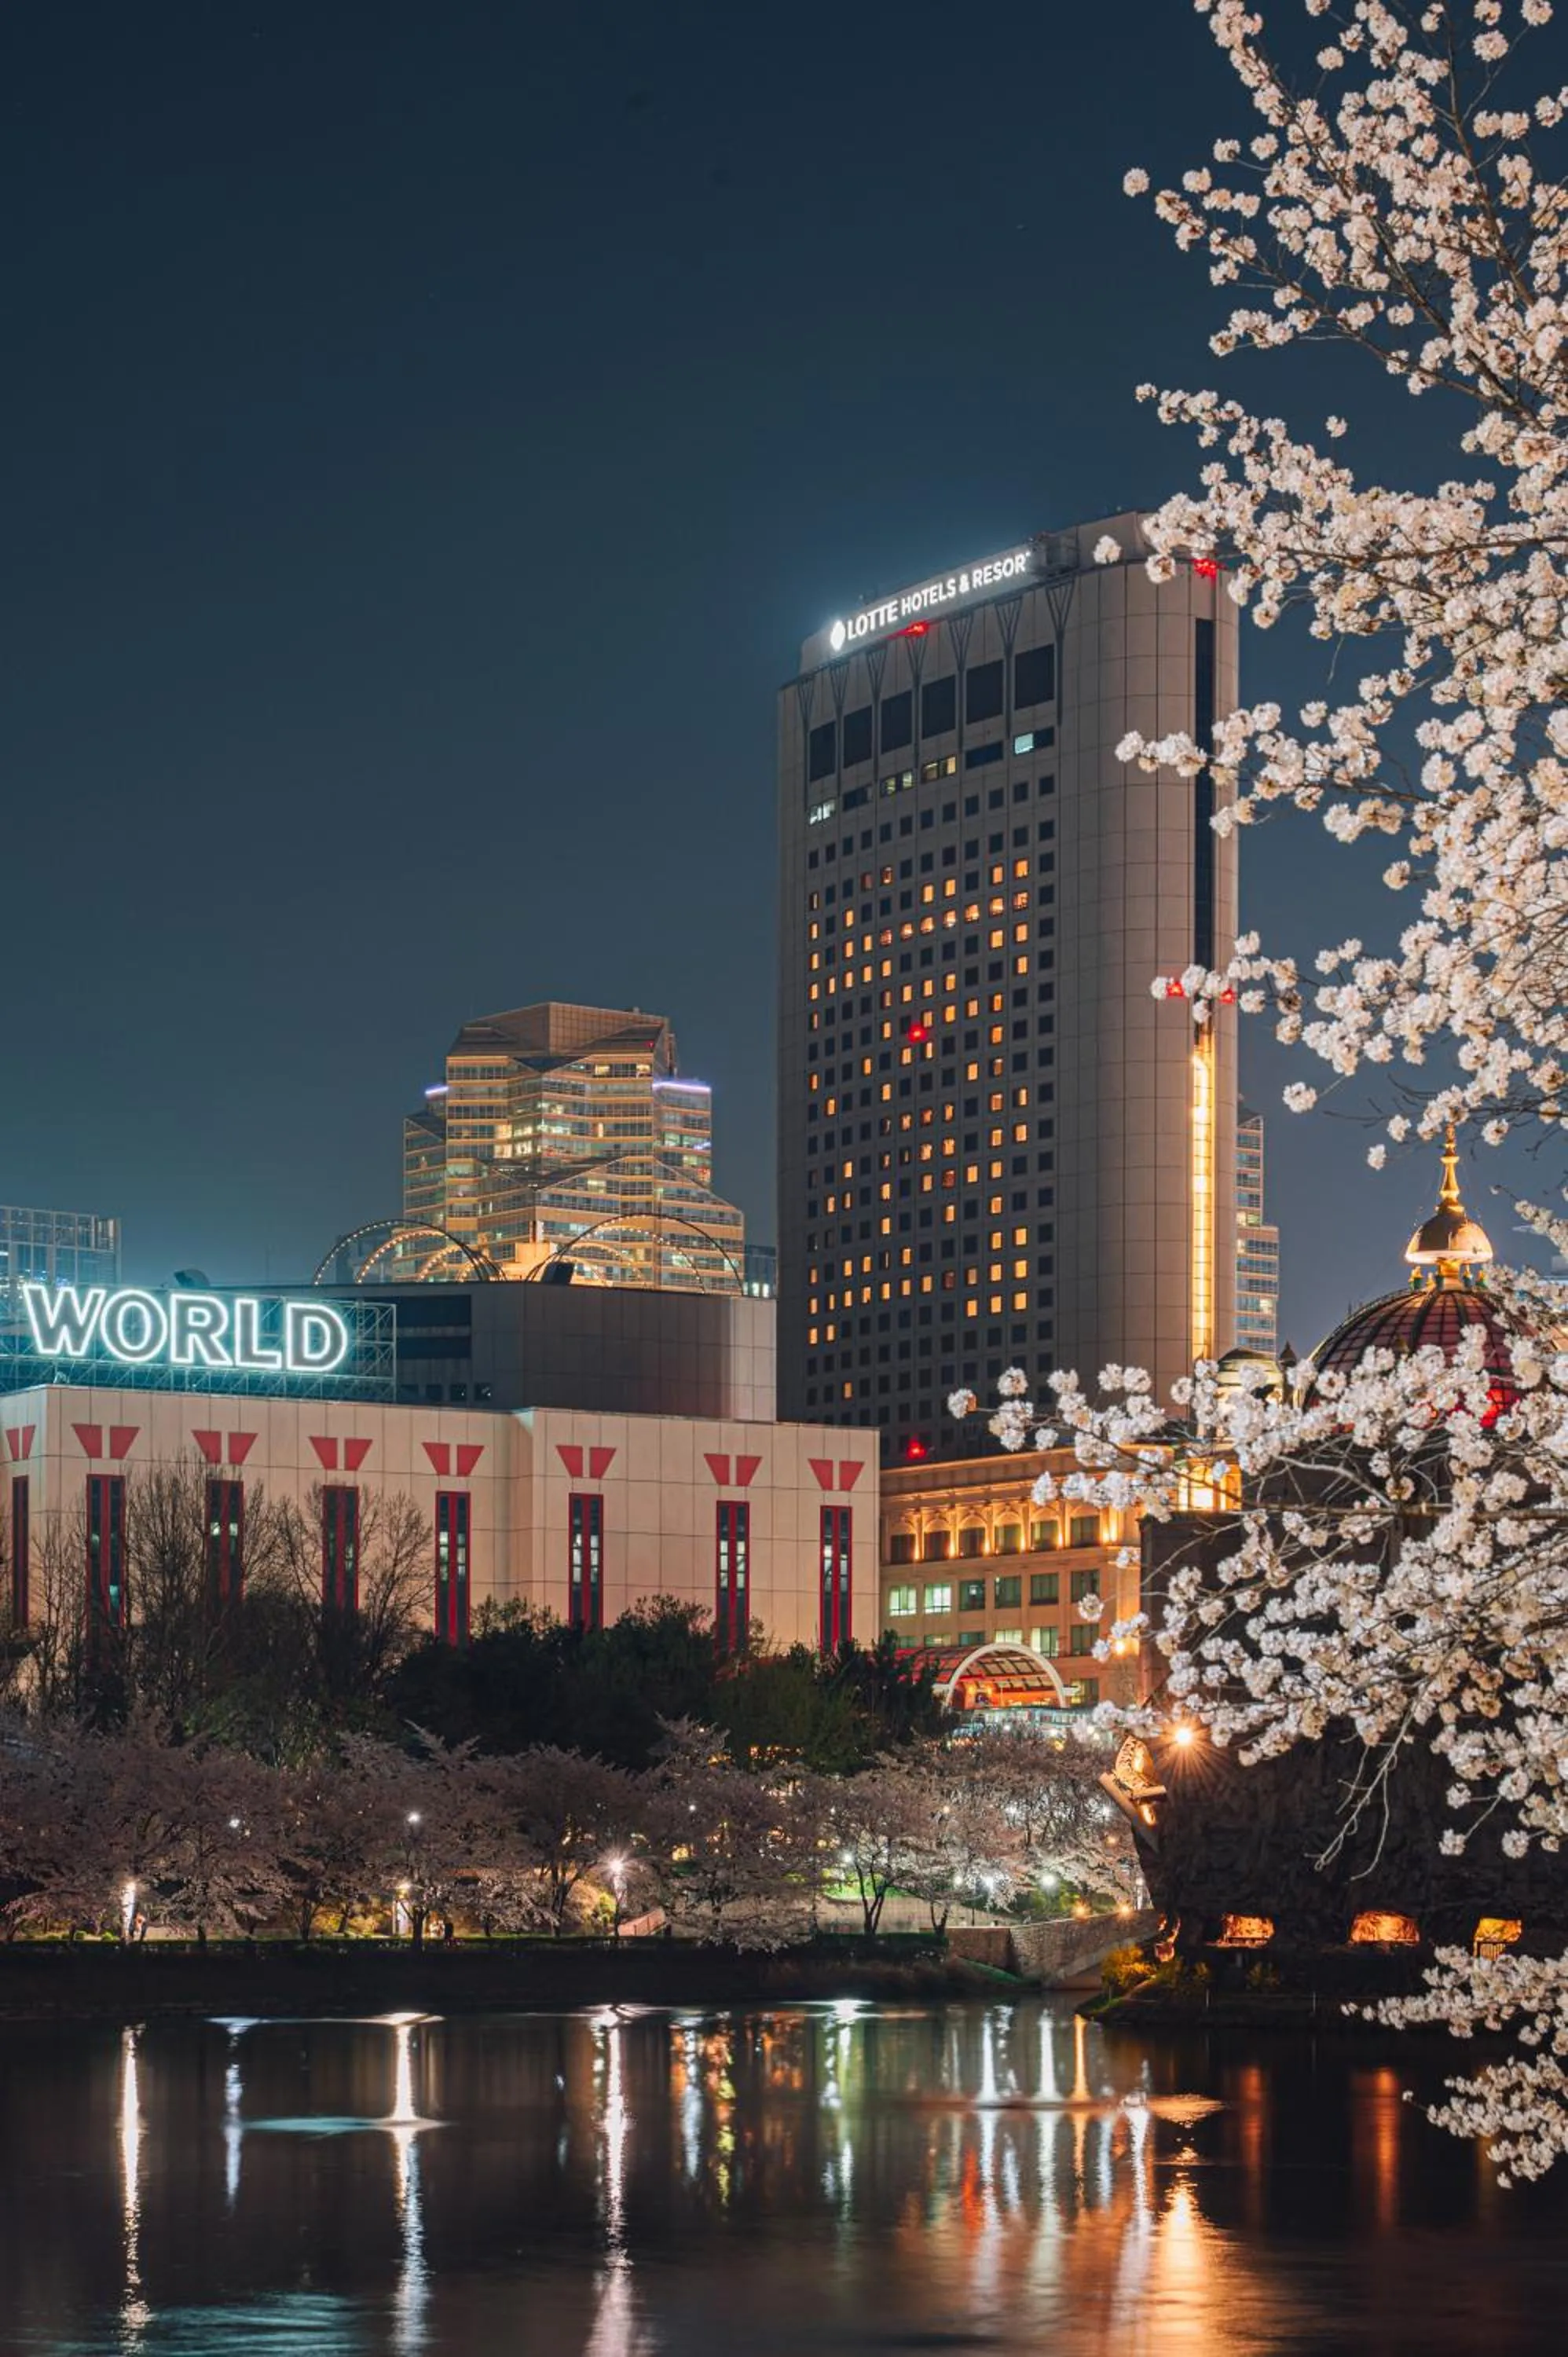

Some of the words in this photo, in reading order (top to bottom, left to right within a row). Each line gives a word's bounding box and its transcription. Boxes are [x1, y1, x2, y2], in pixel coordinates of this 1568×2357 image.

[847, 599, 899, 641] LOTTE
[901, 577, 956, 617] HOTELS
[959, 574, 970, 594] &
[972, 551, 1031, 589] RESOR
[23, 1282, 348, 1373] WORLD
